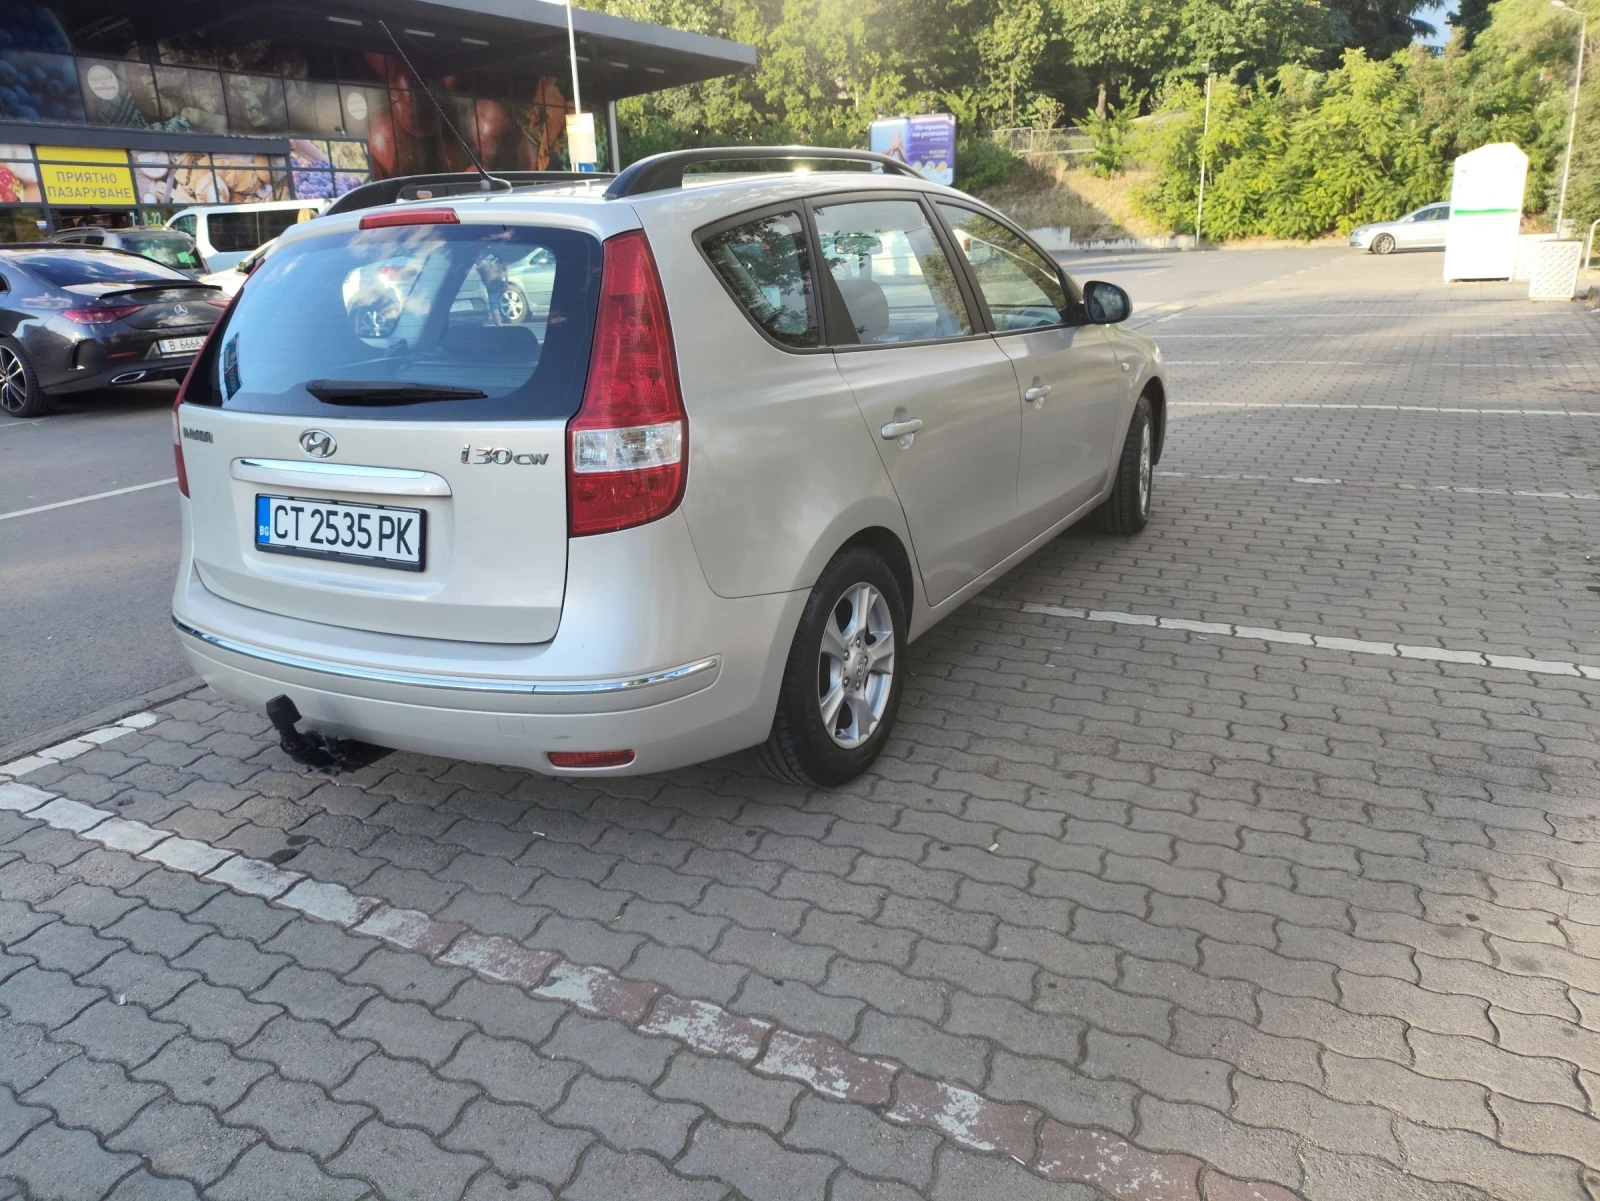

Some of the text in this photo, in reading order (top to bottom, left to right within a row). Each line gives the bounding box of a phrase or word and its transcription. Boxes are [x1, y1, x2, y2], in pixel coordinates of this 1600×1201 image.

[56, 171, 118, 184] ПРИЯТНО
[47, 186, 132, 199] ПАЗАРУВАНЕ
[259, 525, 270, 537] BG
[274, 504, 413, 555] CT 2535 PK
